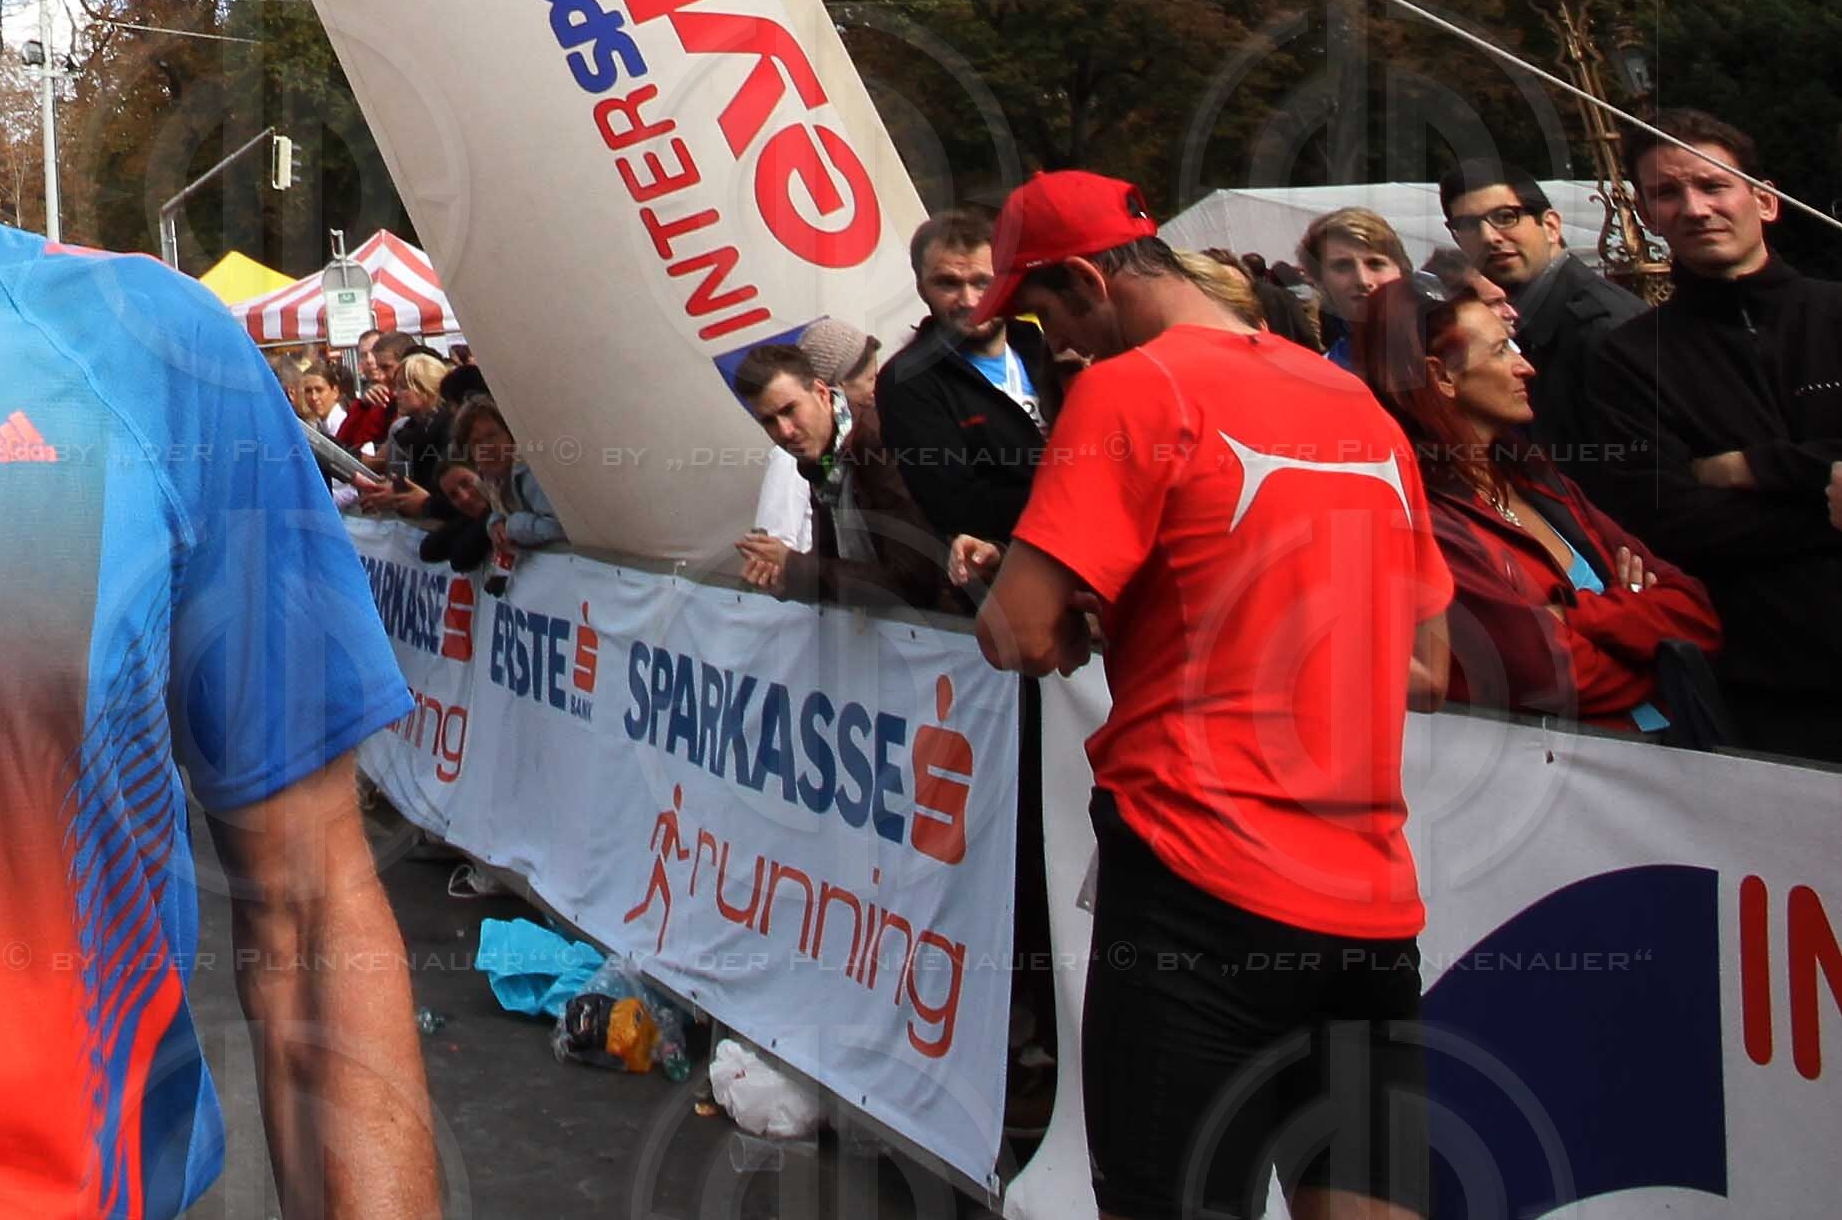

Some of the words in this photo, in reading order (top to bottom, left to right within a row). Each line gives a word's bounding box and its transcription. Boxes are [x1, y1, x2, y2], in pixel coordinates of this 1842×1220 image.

[491, 601, 571, 711] ERSTE
[569, 693, 594, 722] BANK
[624, 640, 908, 844] SPARKASSE
[690, 827, 966, 1059] running
